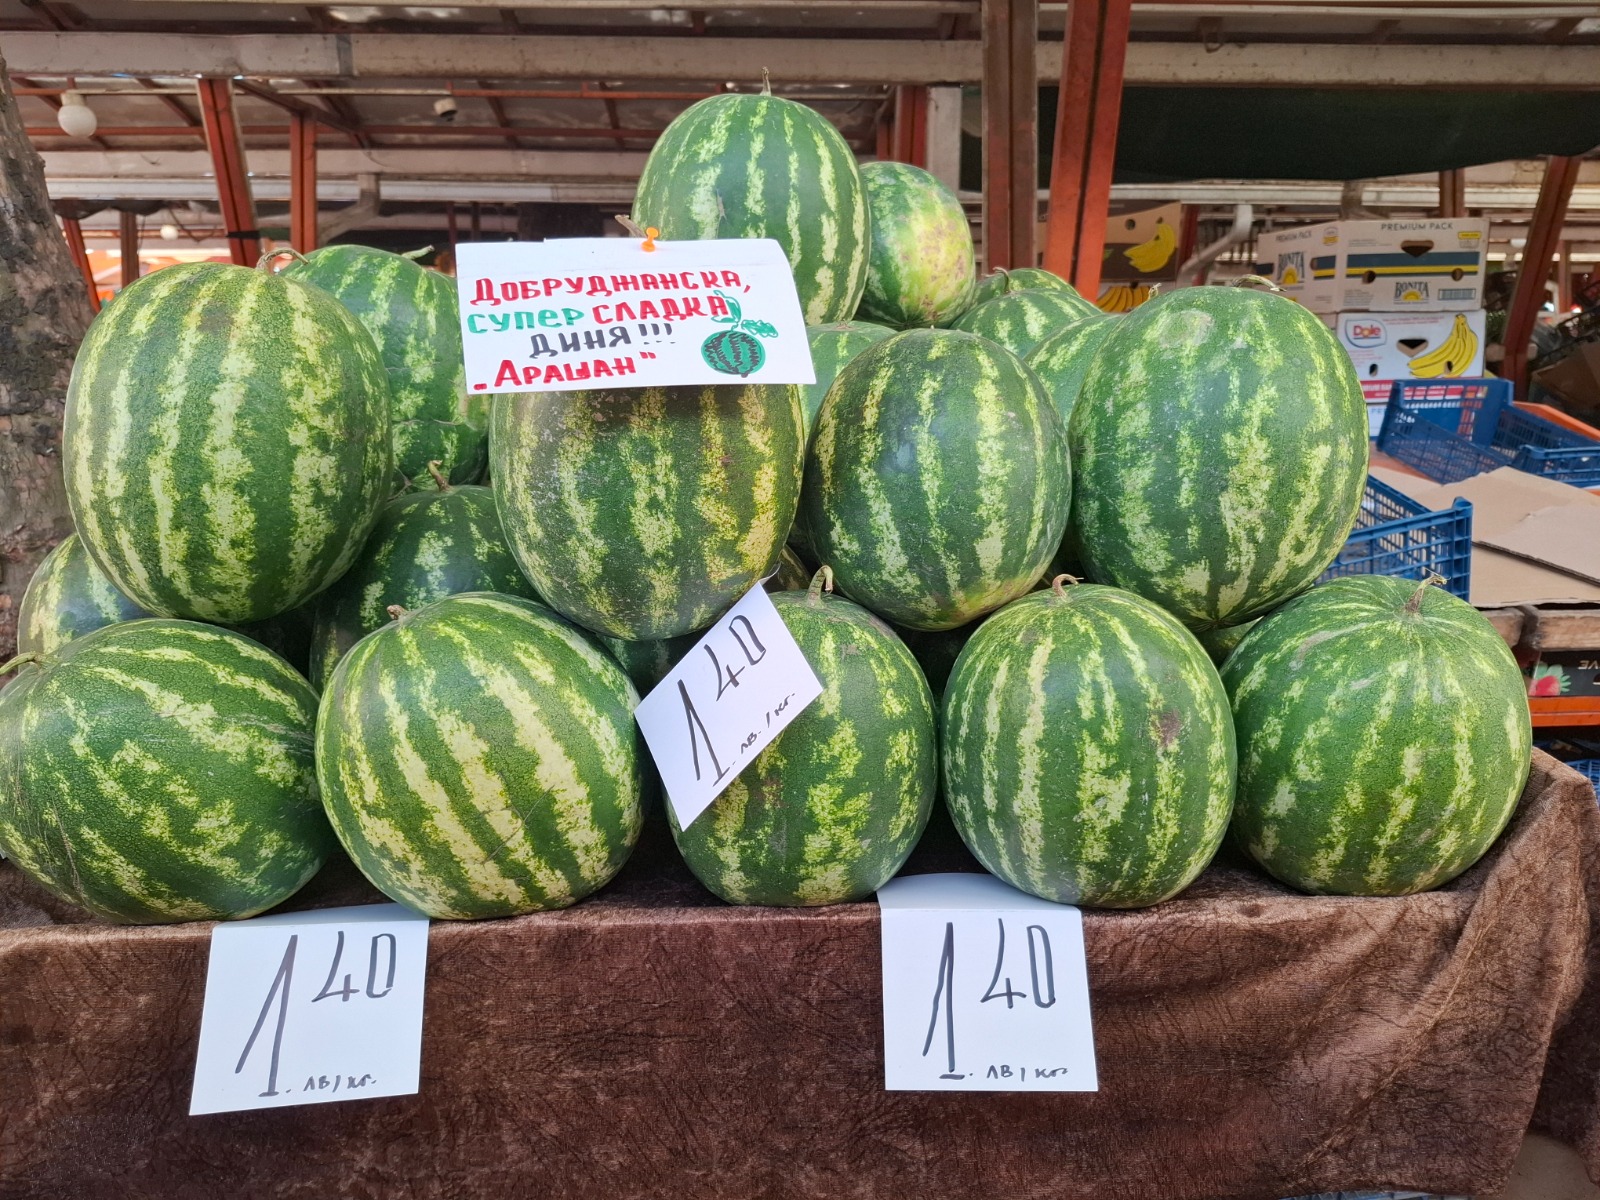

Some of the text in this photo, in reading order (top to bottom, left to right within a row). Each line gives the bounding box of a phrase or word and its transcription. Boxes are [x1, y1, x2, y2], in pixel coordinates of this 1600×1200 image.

[1381, 222, 1454, 231] PREMIUM PACK
[1395, 281, 1430, 298] BONITA
[592, 295, 729, 324] СЛАДКА
[1353, 324, 1382, 338] Dole
